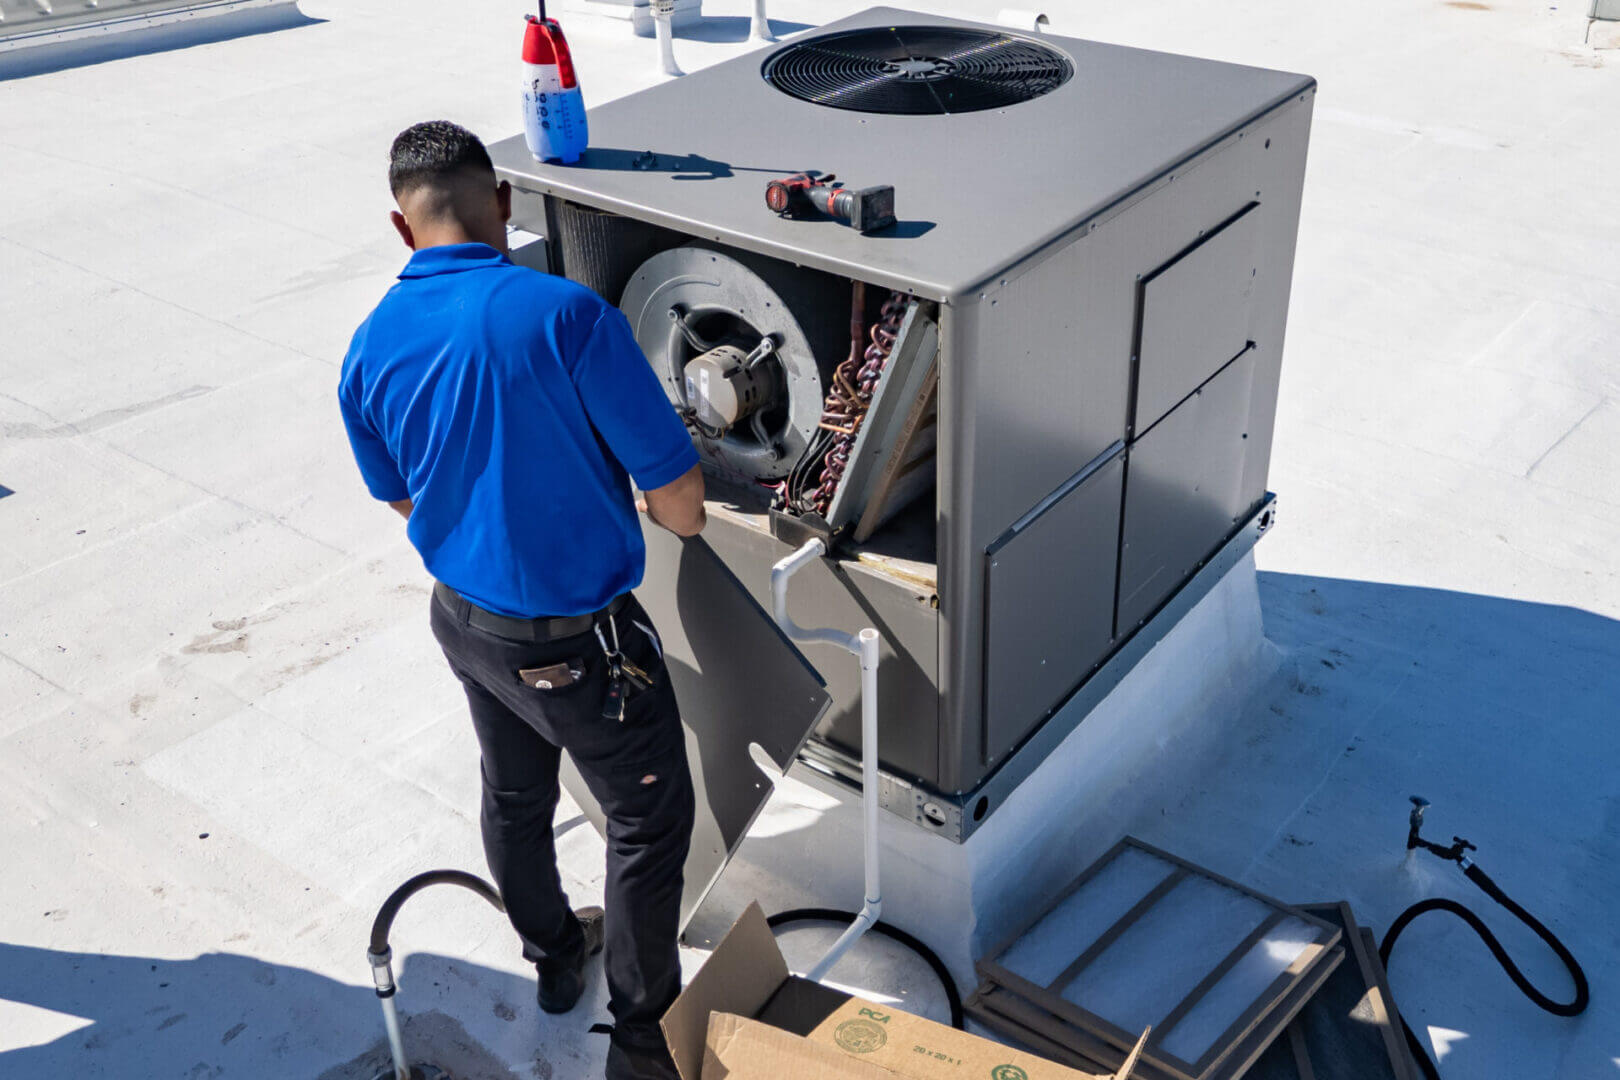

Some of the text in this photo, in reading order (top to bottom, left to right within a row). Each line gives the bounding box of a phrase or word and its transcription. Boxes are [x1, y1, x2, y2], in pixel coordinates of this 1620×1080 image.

[858, 1007, 891, 1024] PCA
[913, 1045, 926, 1054] 20
[934, 1052, 947, 1061] 20
